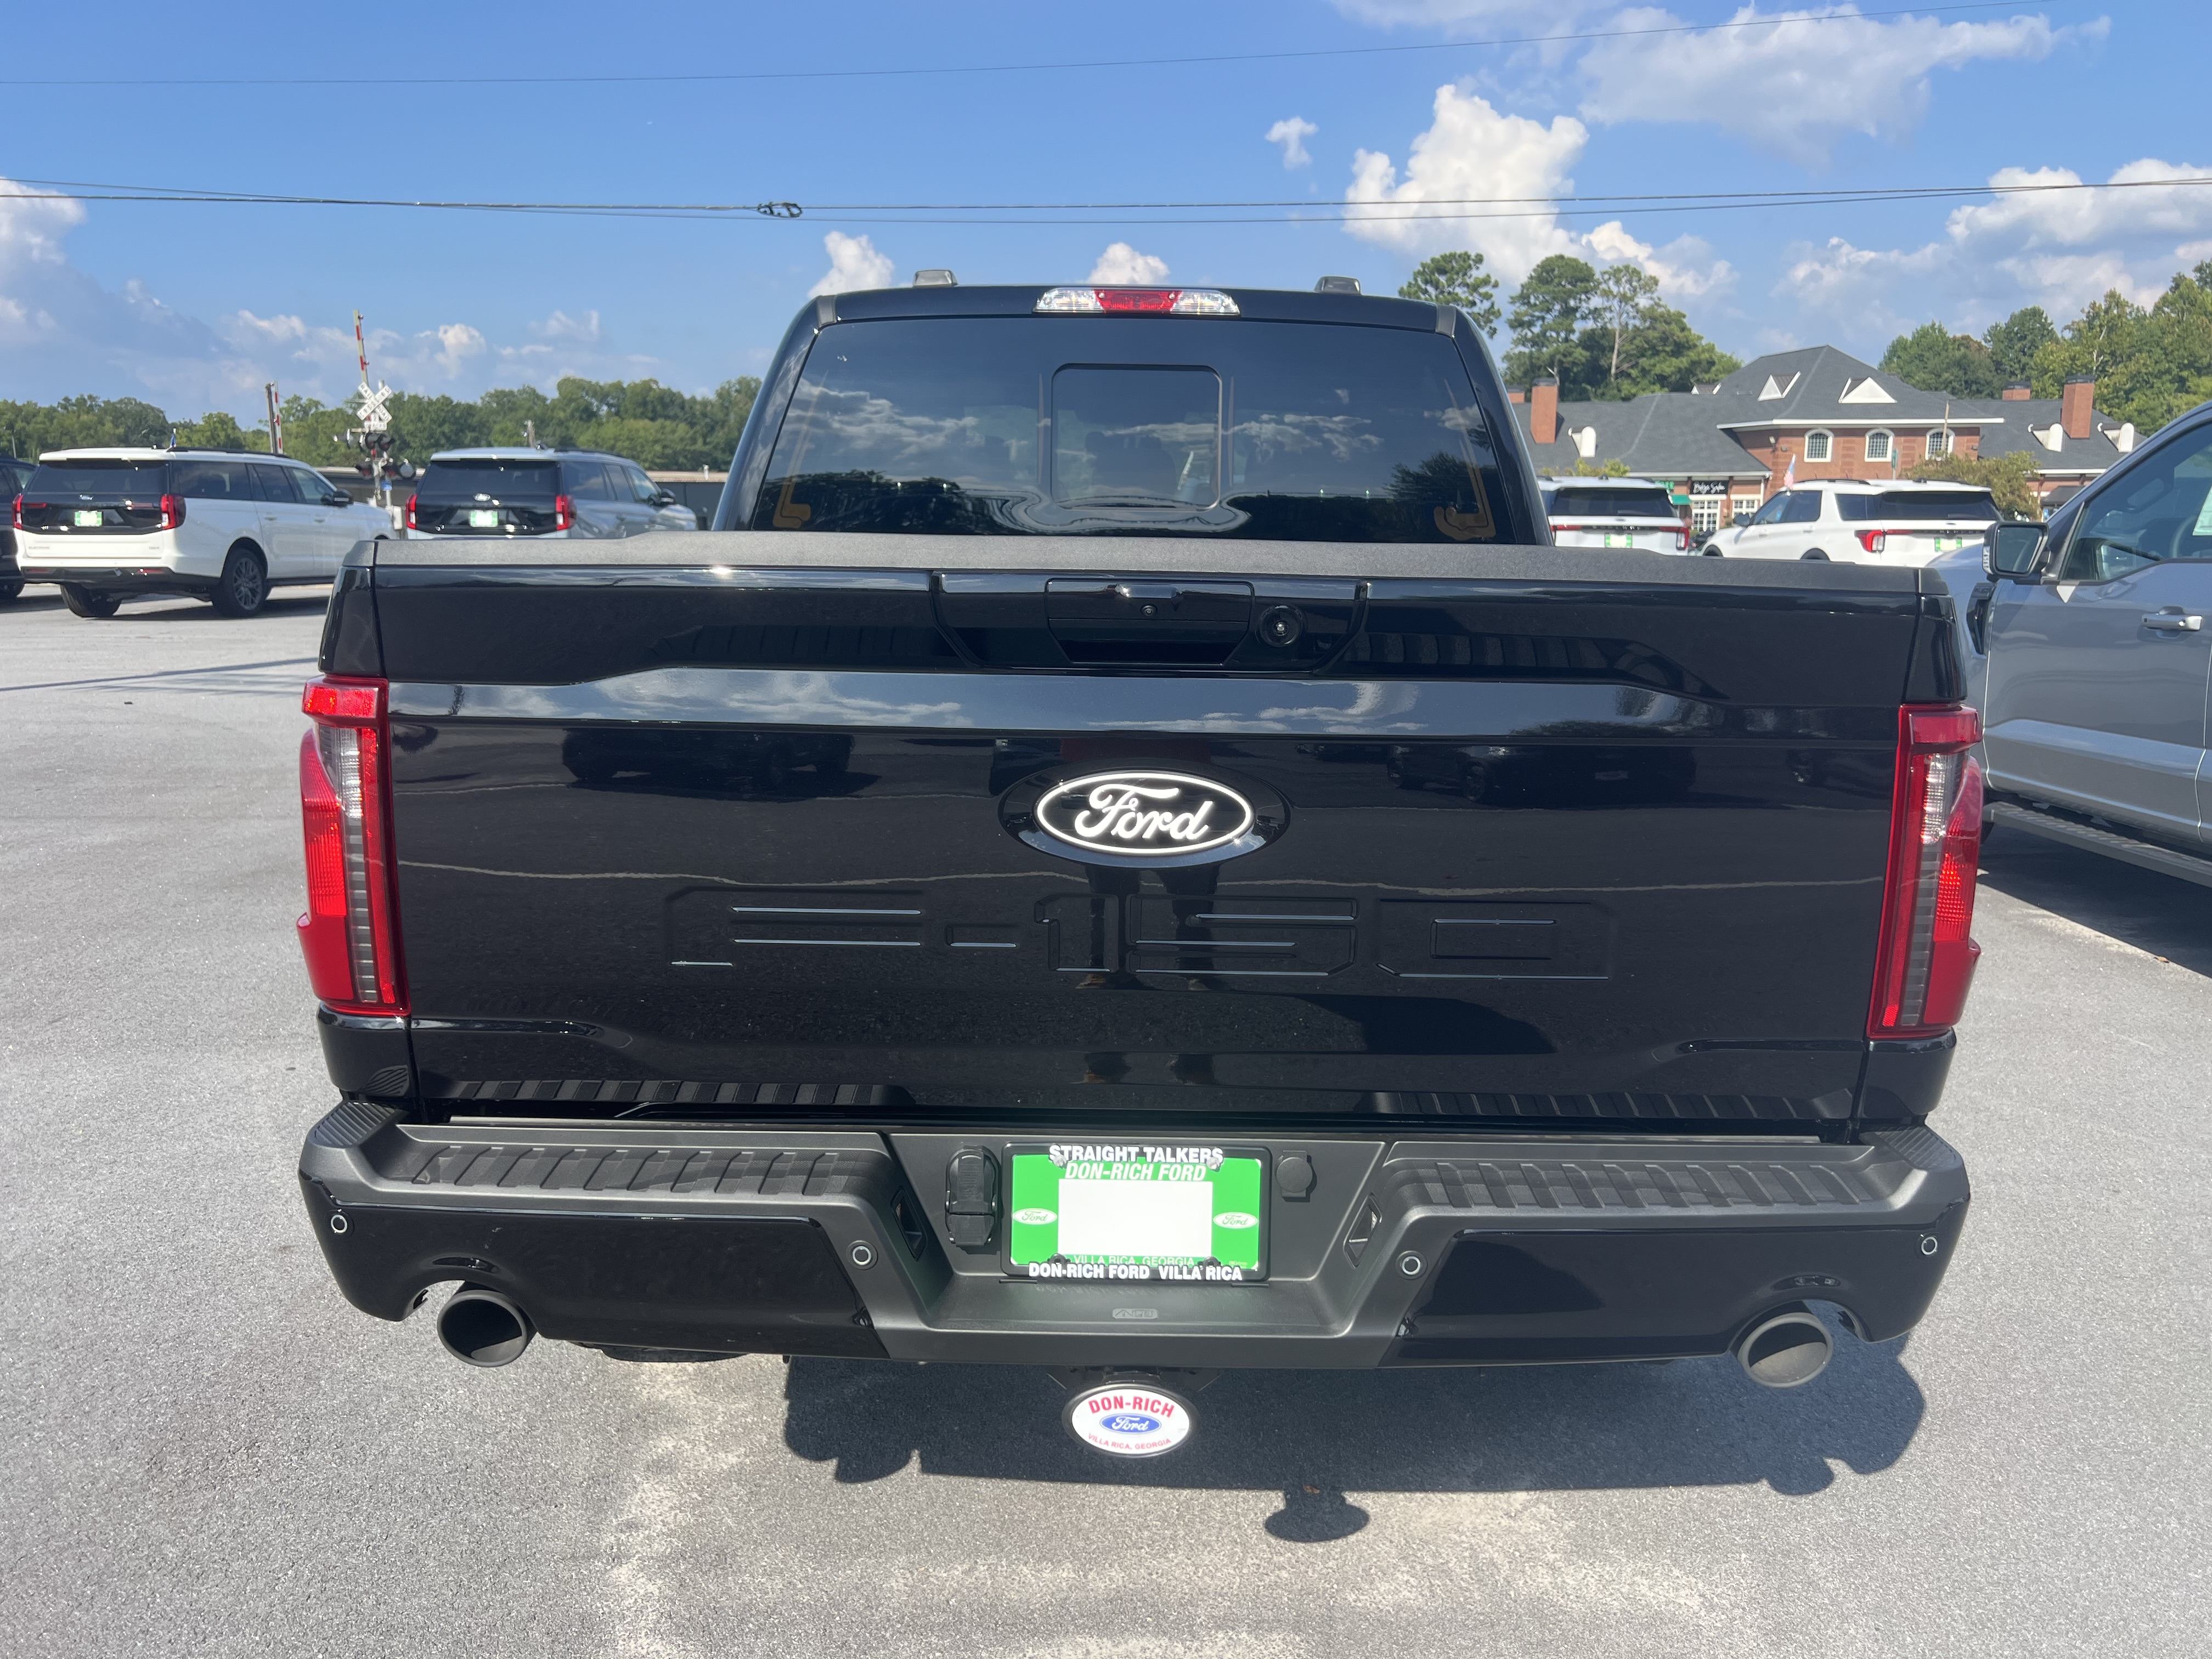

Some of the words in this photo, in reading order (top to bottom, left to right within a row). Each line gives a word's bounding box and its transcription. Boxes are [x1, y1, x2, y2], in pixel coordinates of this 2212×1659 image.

[359, 387, 390, 417] CROSSNG
[1074, 784, 1213, 840] Ford
[665, 887, 1616, 981] F-150
[1049, 1146, 1139, 1161] STRAIGHT
[1143, 1147, 1224, 1164] TALKERS
[1065, 1163, 1153, 1180] DON-RICH
[1157, 1165, 1206, 1181] FORD
[1022, 1210, 1047, 1222] Ford
[1222, 1214, 1248, 1226] Ford
[1074, 1255, 1105, 1264] VILLA
[1142, 1257, 1194, 1267] GEORGIA
[1029, 1262, 1104, 1278] DON-RICH
[1108, 1265, 1150, 1279] FORD
[1159, 1265, 1201, 1280] VILLA
[1206, 1266, 1242, 1280] RICA
[1088, 1396, 1175, 1418] DON-RICH
[1111, 1416, 1149, 1431] Ford
[1088, 1433, 1108, 1446] VILLA
[1135, 1438, 1171, 1450] GEORGIA
